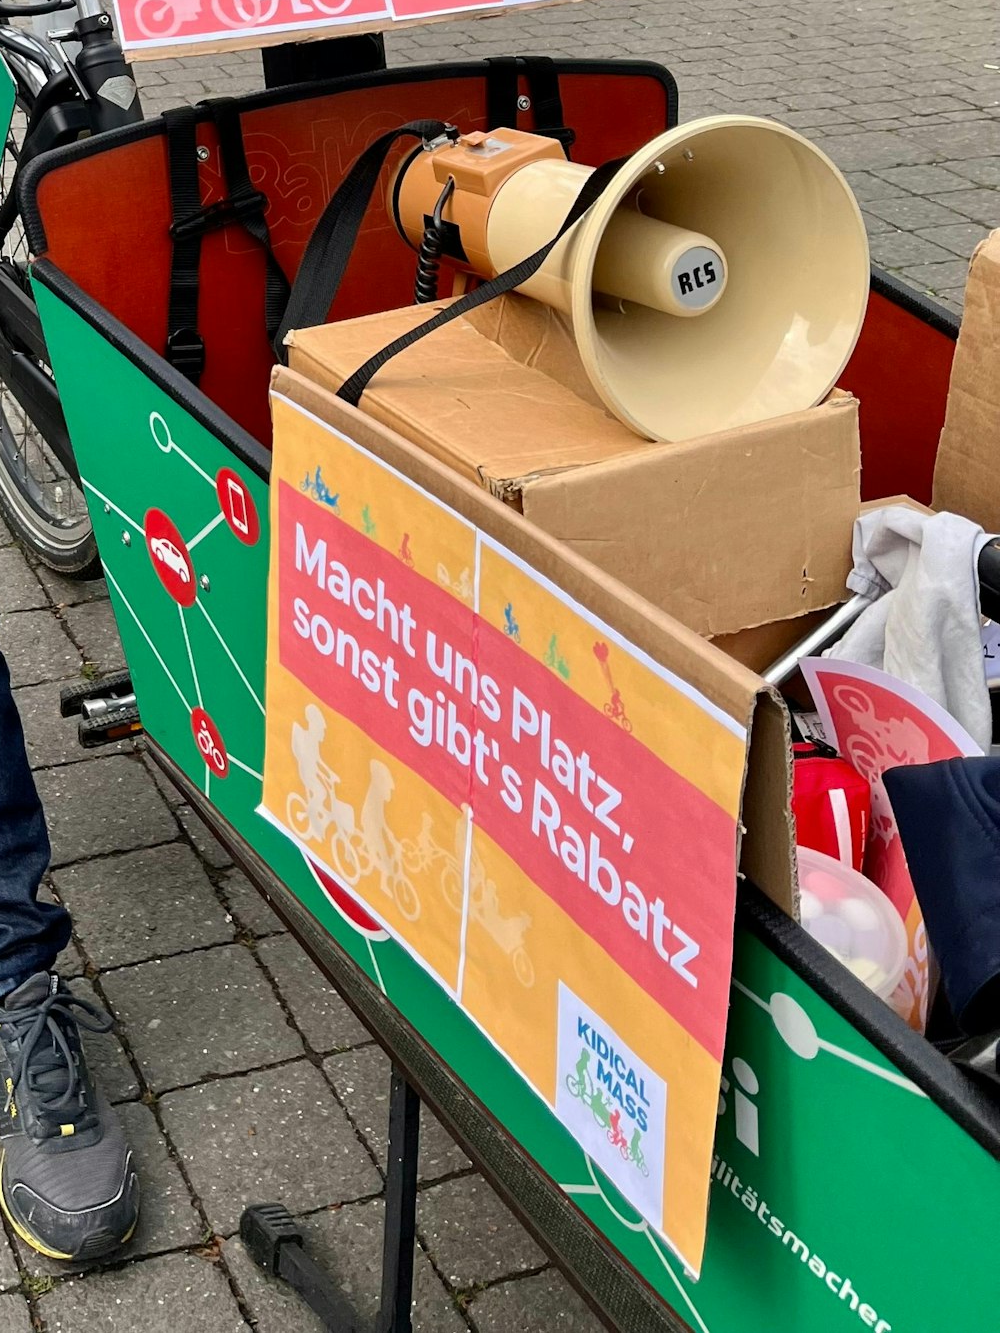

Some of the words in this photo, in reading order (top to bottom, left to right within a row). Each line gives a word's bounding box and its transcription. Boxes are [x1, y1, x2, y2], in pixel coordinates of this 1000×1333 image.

[677, 260, 717, 296] RCS
[295, 524, 416, 656] Macht
[426, 630, 500, 722] uns
[513, 687, 635, 854] Platz,
[293, 595, 400, 708] sonst
[408, 686, 523, 815] gibt's
[531, 778, 700, 989] Rabatz
[577, 1015, 651, 1108] KIDICAL
[596, 1059, 648, 1133] MASS
[709, 1153, 892, 1333] ilitätsmacher
